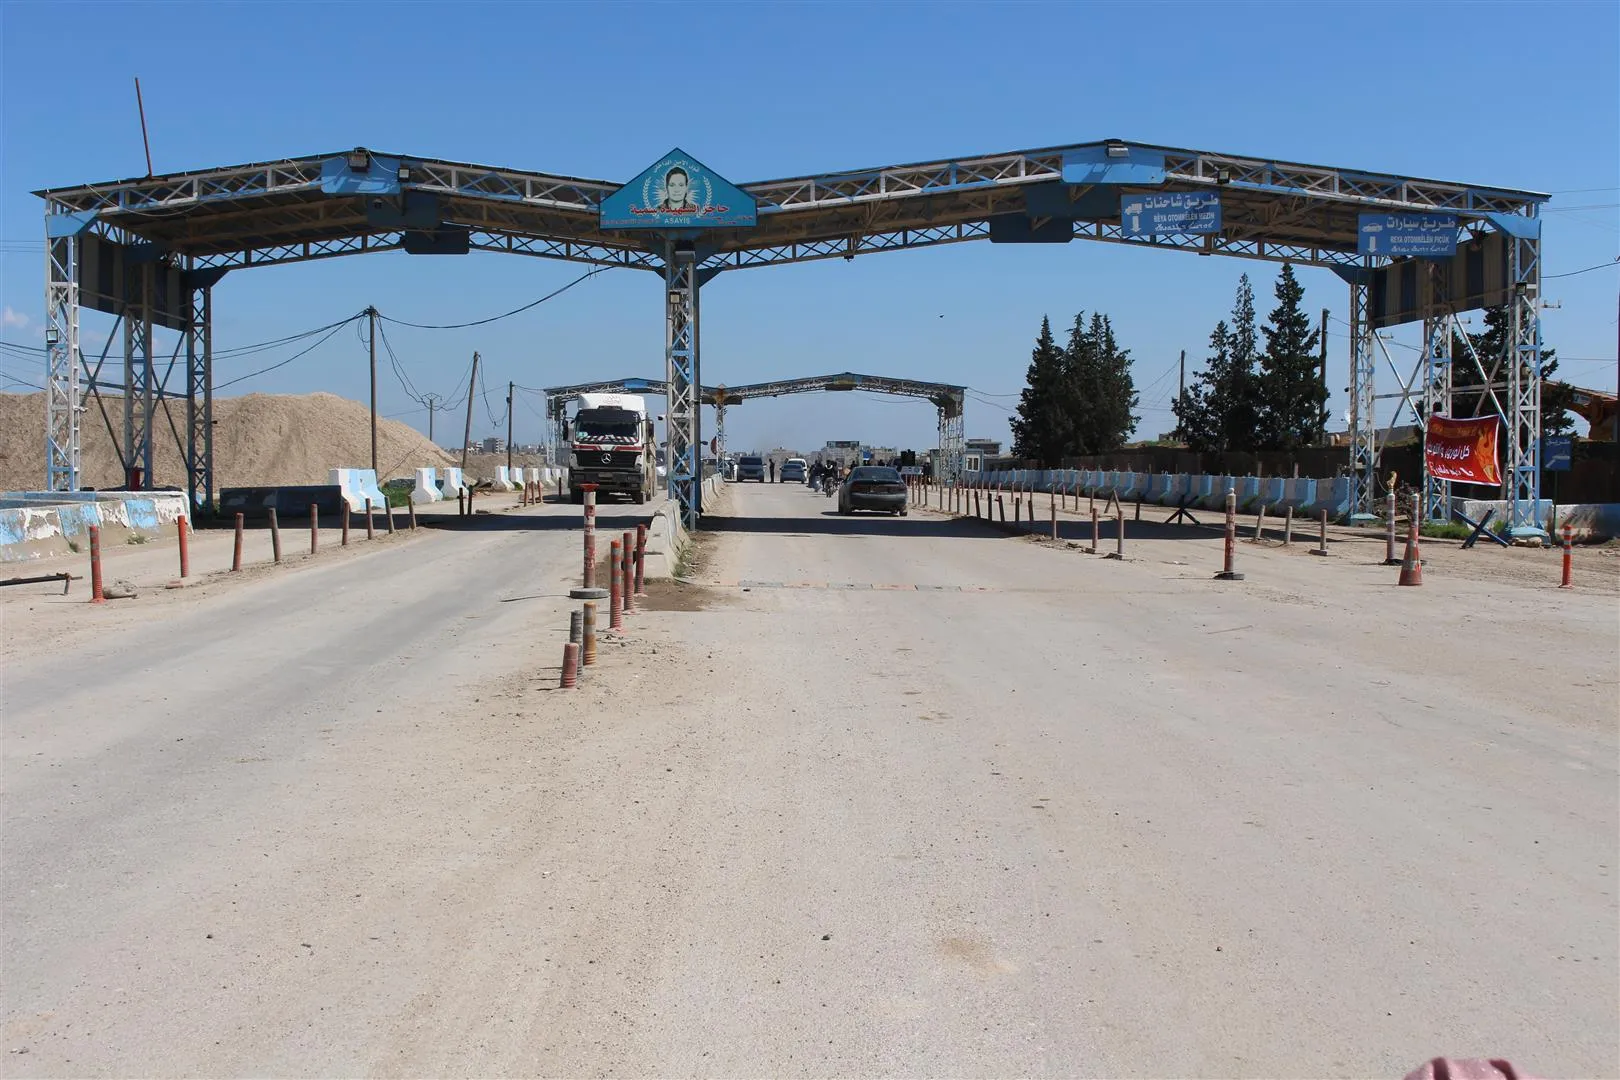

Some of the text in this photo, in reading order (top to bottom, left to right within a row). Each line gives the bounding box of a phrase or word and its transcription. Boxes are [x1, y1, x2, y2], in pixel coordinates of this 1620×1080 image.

[629, 202, 729, 216] حاجز الشهيدة سمية
[1144, 193, 1219, 209] طريق شاحنات
[1386, 216, 1456, 232] طريق سيارات
